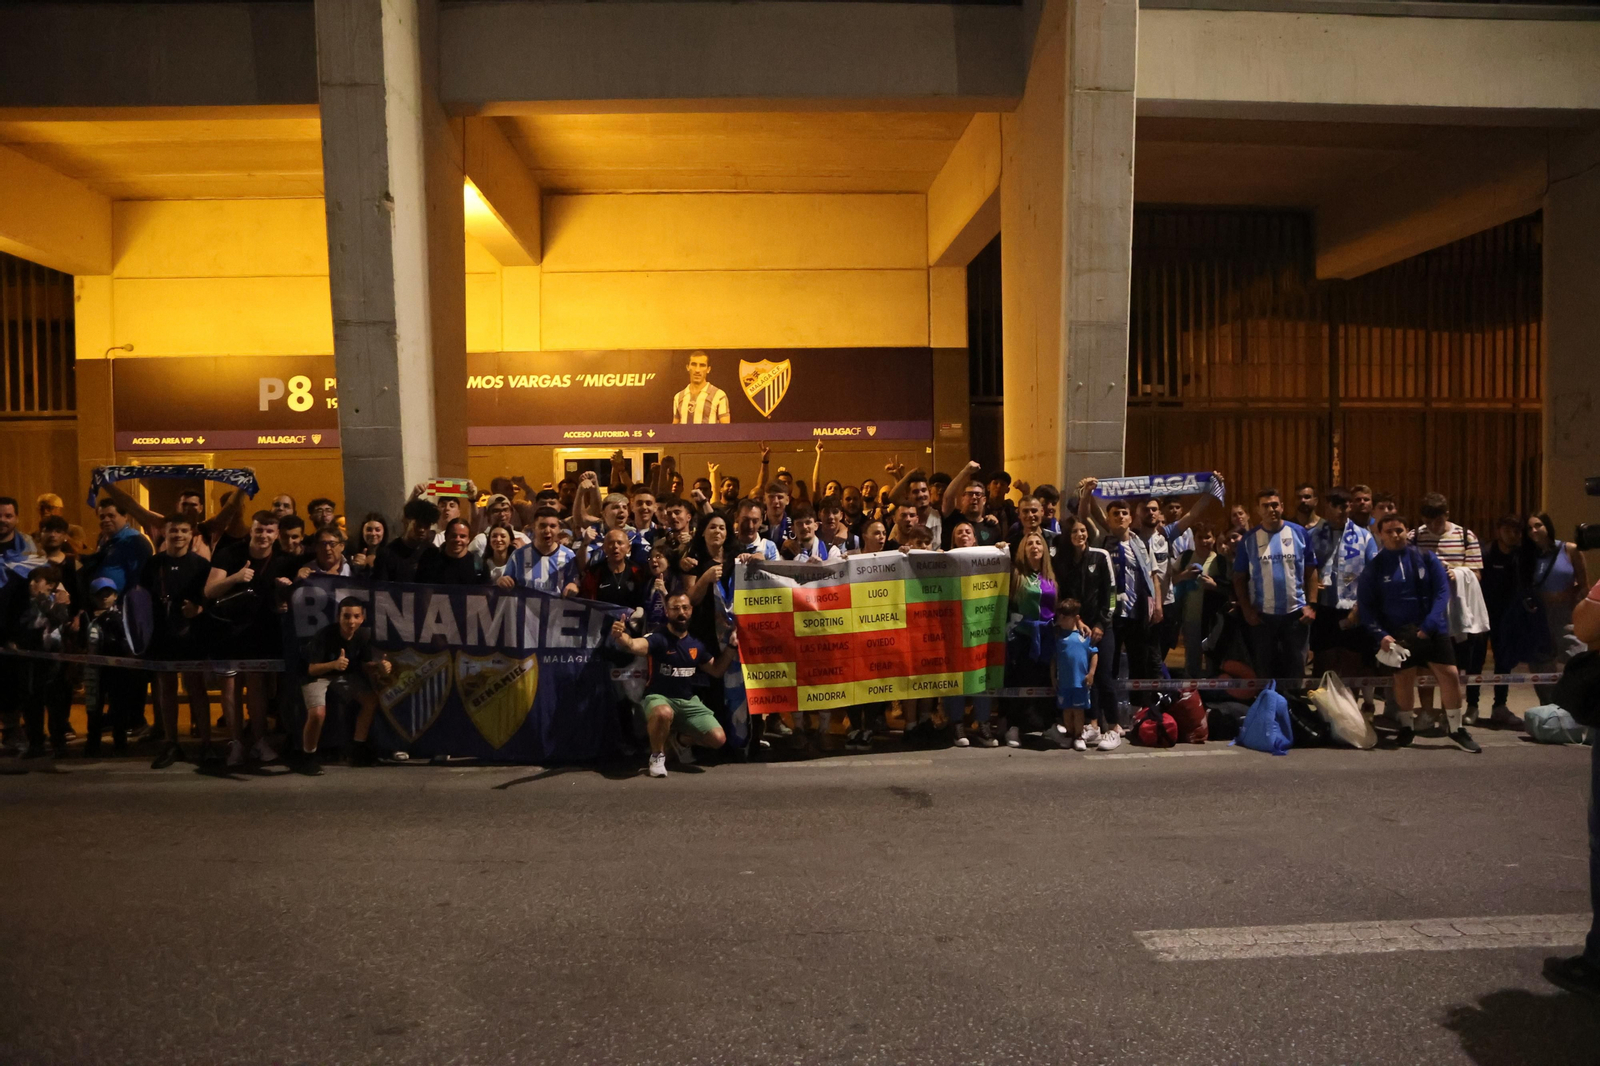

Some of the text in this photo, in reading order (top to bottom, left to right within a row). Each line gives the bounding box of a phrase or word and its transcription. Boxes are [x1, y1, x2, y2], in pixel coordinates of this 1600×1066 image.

[508, 374, 571, 387] VARGAS
[575, 372, 655, 387] "MIGUELI"
[259, 375, 314, 412] P8
[563, 431, 591, 439] ACCESO
[1101, 474, 1199, 497] MALAGA
[916, 561, 947, 570] RACING
[971, 557, 1001, 567] MALAGA
[856, 563, 896, 575] SPORTING
[922, 585, 942, 594] IBIZA
[972, 580, 998, 591] HUESCA
[806, 592, 839, 603] BURGOS
[868, 588, 888, 599] LUGO
[744, 595, 783, 606] TENERIFE
[803, 616, 844, 628] SPORTING
[859, 612, 899, 624] VILLAREAL
[747, 621, 781, 630] HUESCA
[800, 641, 849, 653] LAS PALMAS
[866, 637, 895, 648] OVIEDO
[748, 645, 783, 656] BURGOS
[921, 656, 950, 668] OVIEDO
[747, 670, 787, 680] ANDORRA
[808, 666, 843, 677] LEVANTE
[472, 665, 527, 708] BENAMIEL
[868, 684, 893, 695] PONFE
[913, 680, 958, 691] CARTAGENA
[749, 694, 788, 705] GRANADA
[806, 690, 846, 703] ANDORRA
